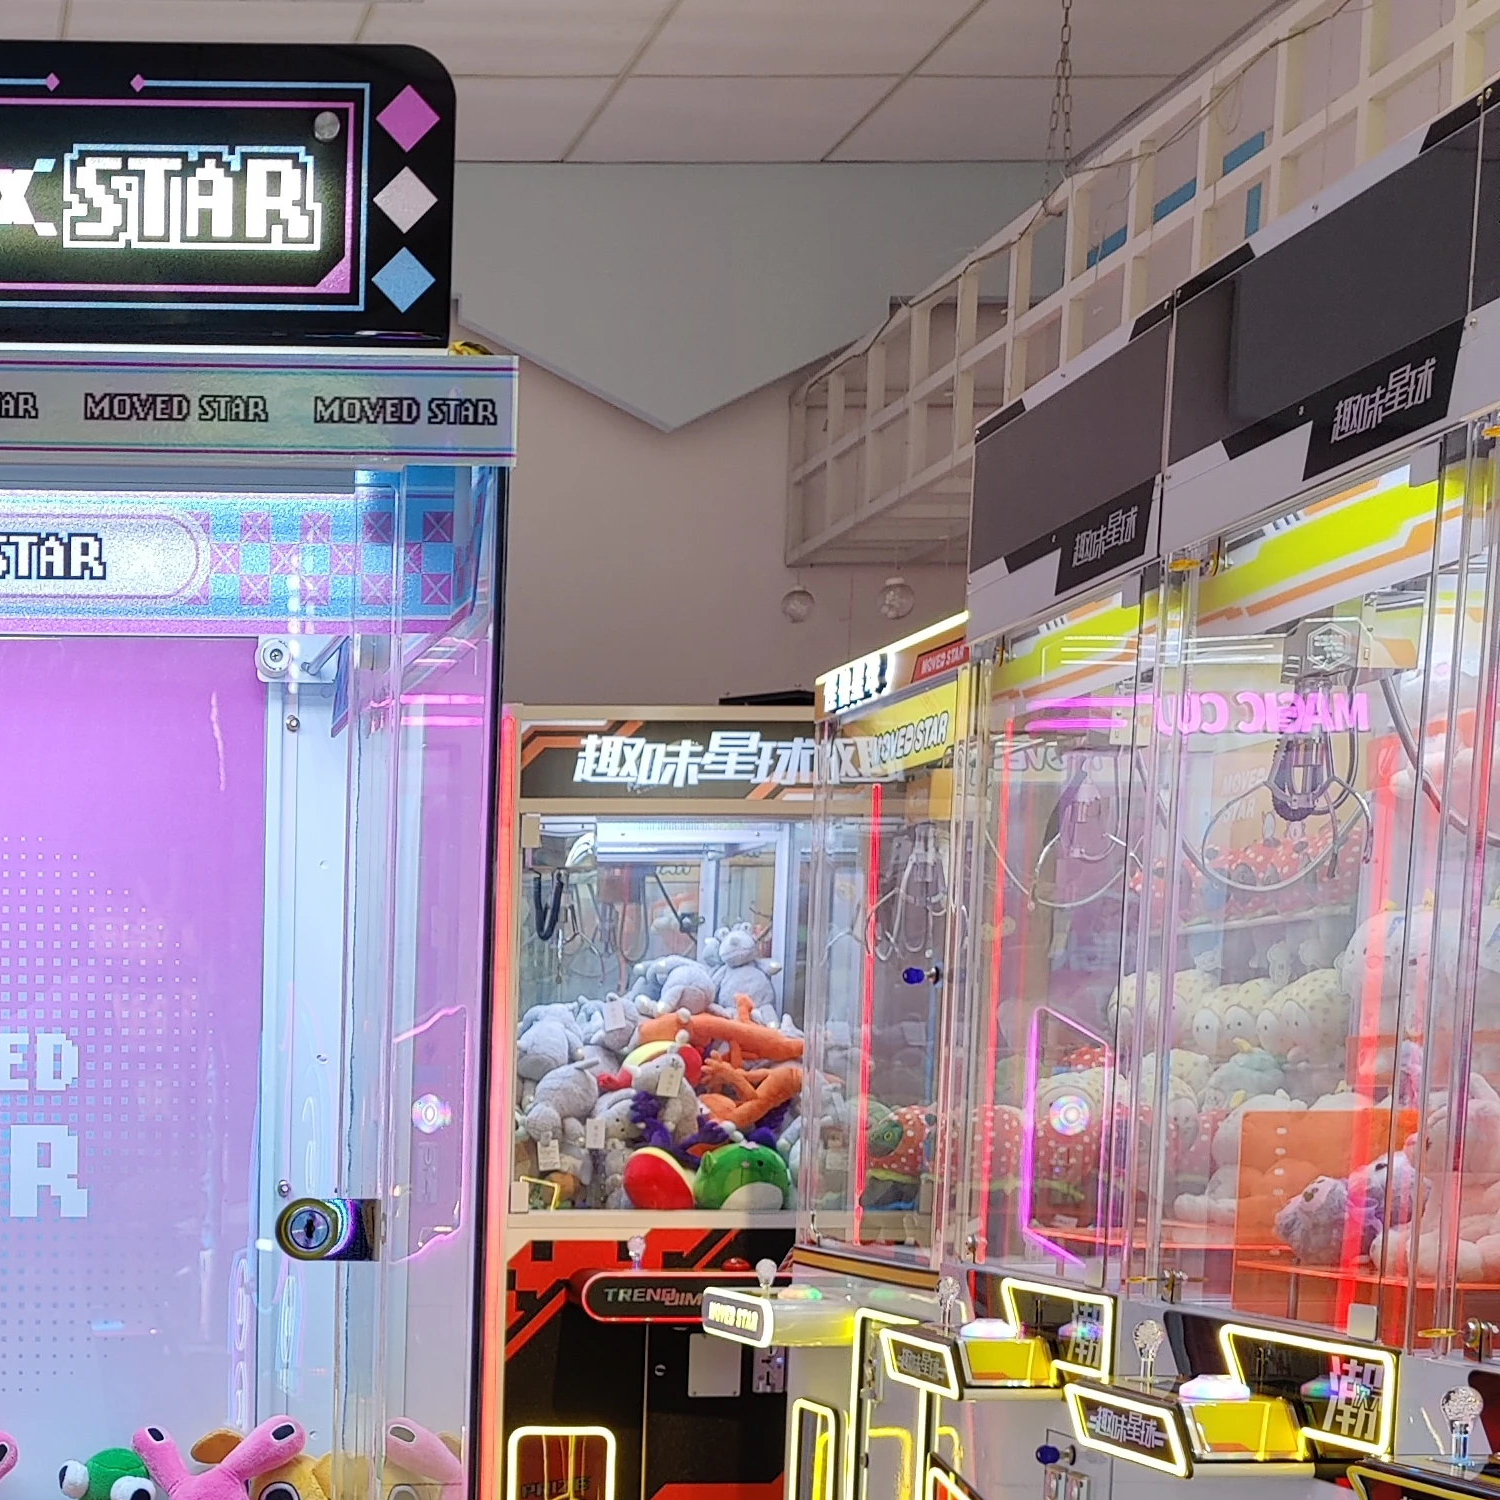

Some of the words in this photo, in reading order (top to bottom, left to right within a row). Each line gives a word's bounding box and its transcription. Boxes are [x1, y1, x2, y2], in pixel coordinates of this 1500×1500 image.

[63, 144, 322, 250] STAR
[84, 393, 190, 420] MOVED
[198, 394, 268, 422] STAR
[313, 396, 420, 424] MOVED
[427, 398, 497, 425] STAR
[1330, 357, 1437, 444] 趣味星球
[1072, 505, 1138, 568] 趣味星球
[915, 710, 949, 752] STAR
